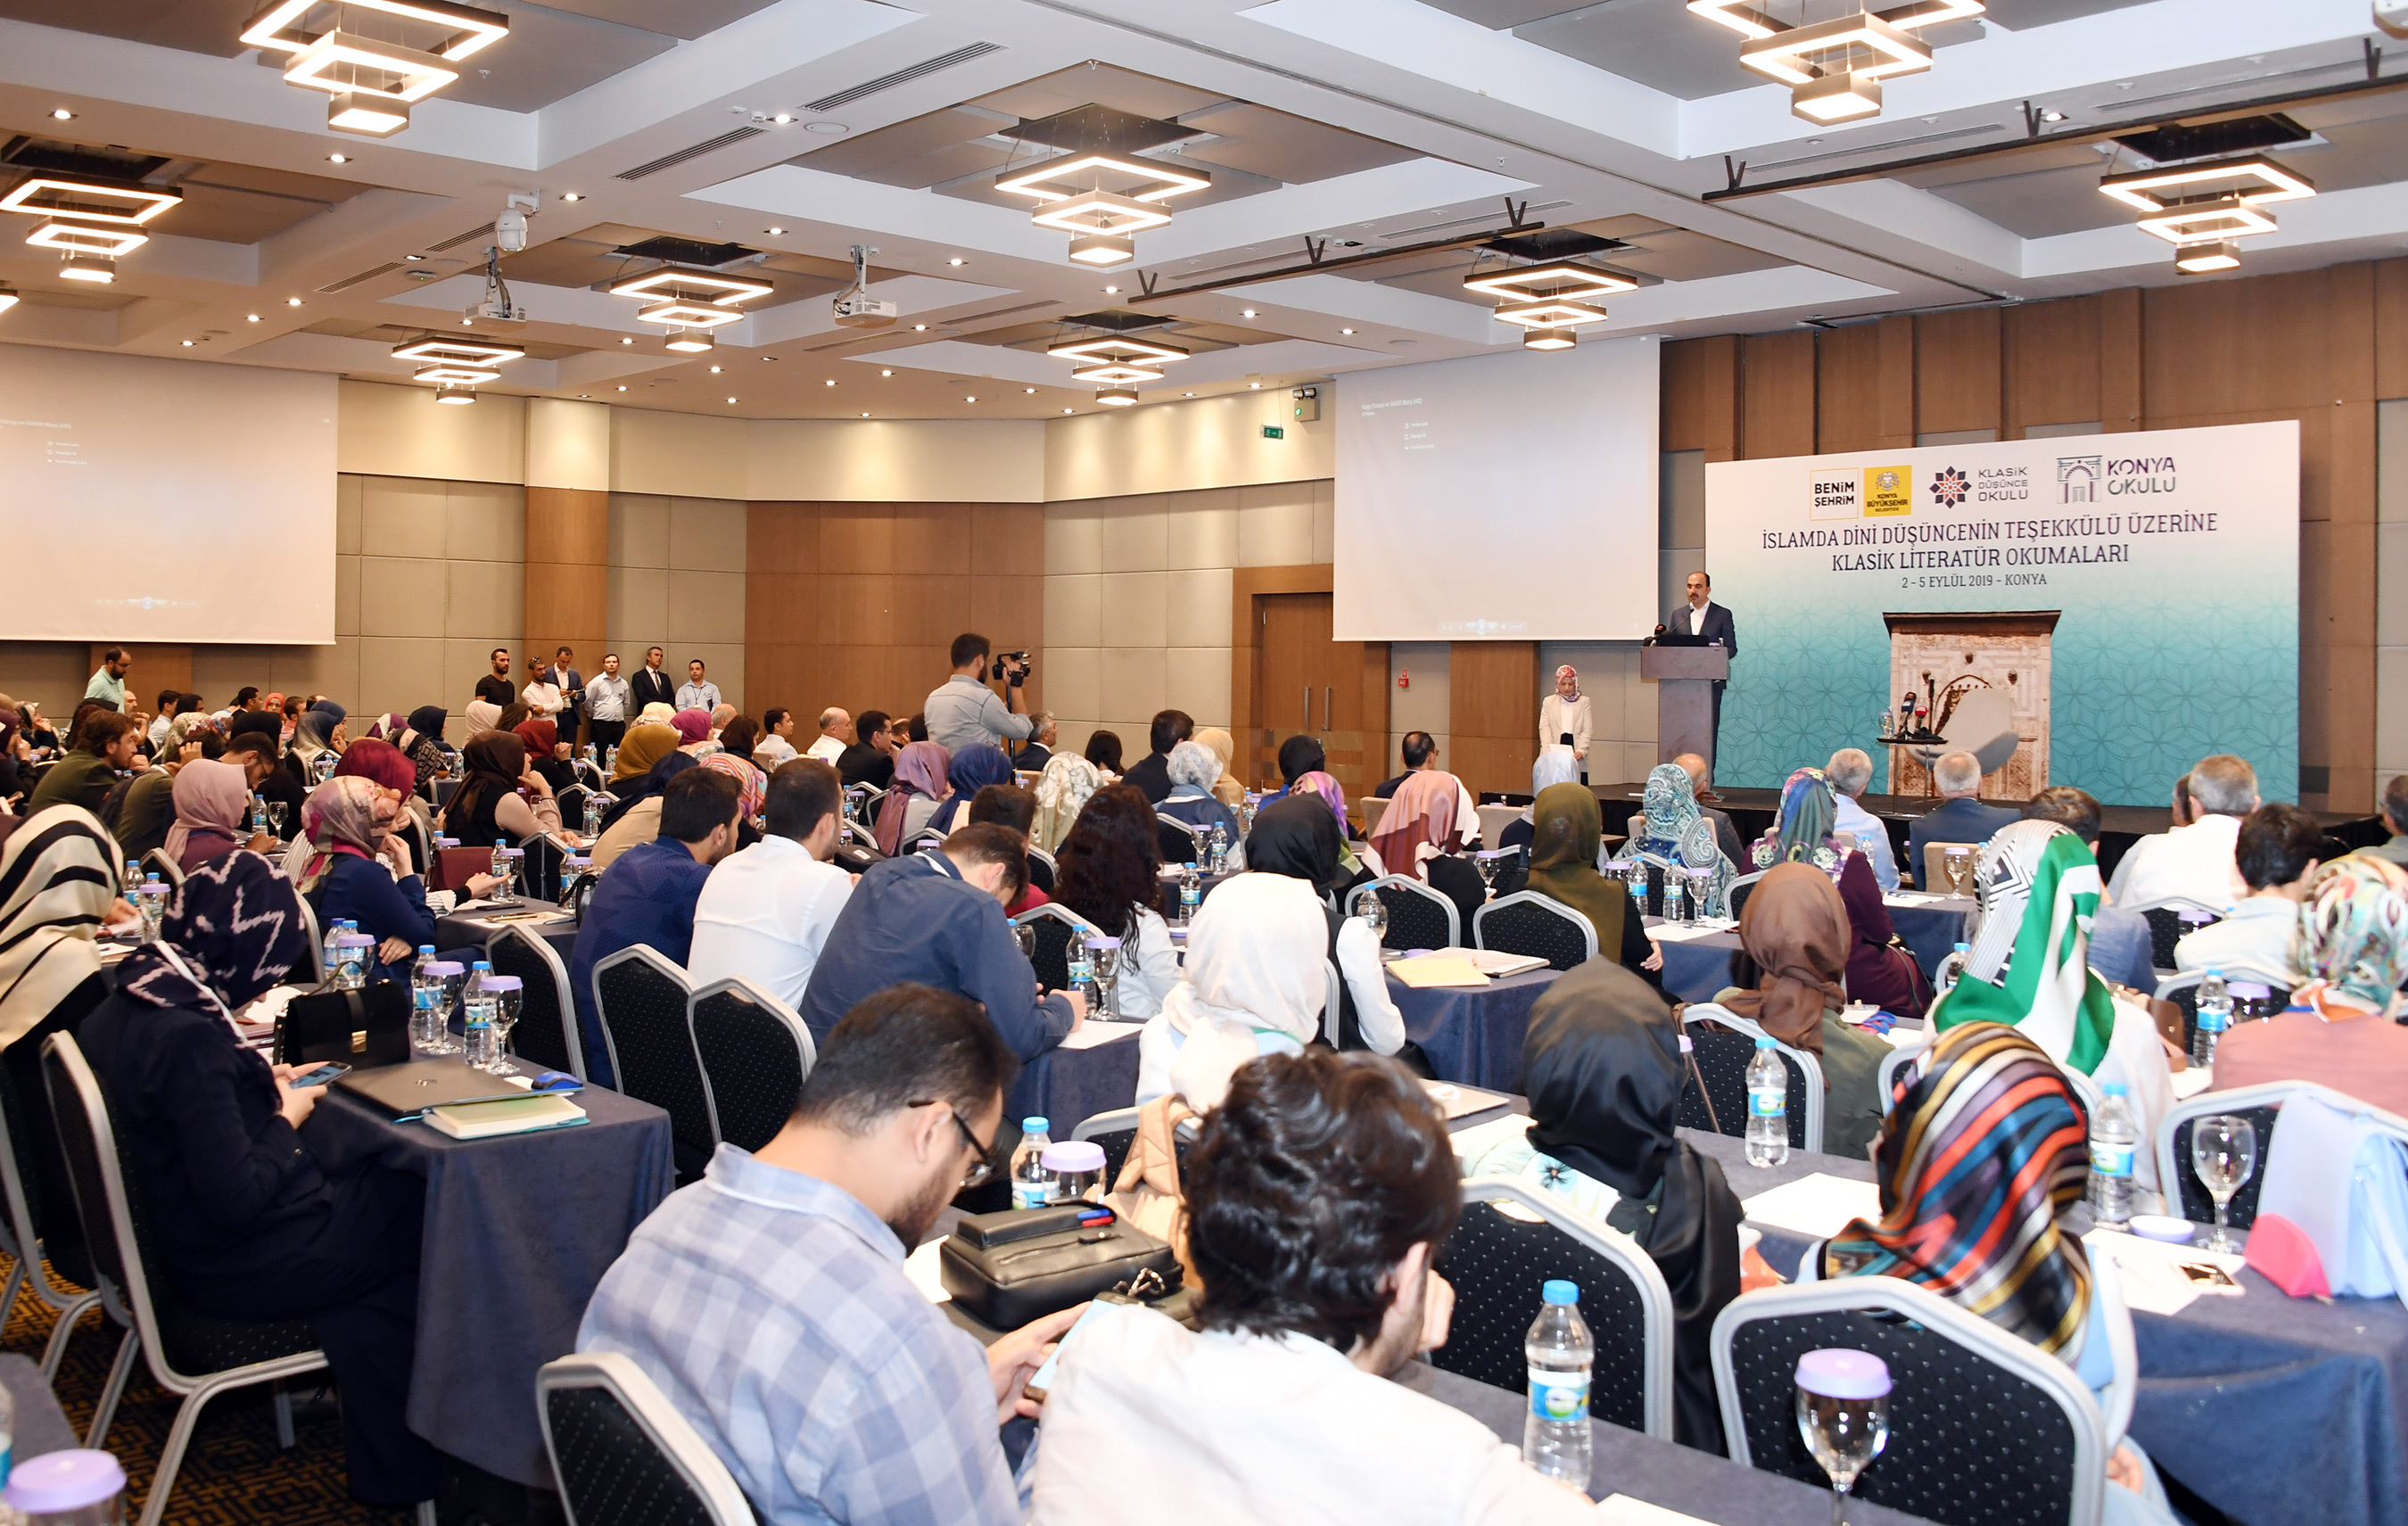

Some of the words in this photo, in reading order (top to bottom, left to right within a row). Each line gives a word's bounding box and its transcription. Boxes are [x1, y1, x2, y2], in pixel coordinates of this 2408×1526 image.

[2107, 457, 2175, 476] KONYA
[2107, 476, 2175, 496] OKULU
[1977, 490, 2029, 502] OKULU
[1762, 529, 1839, 549] İSLAMDA
[1843, 524, 1877, 546] DİNİ
[1882, 519, 2000, 547] DÜŞÜNCENİN
[2005, 514, 2122, 542] TEŞEKKÜLÜ
[2129, 510, 2218, 534] ÜZERİNE
[1832, 549, 1895, 572] KLASİK
[1900, 546, 2001, 569] LİTERATÜR
[2006, 544, 2130, 566] OKUMALARI
[1901, 577, 1909, 589] 2
[1918, 576, 1926, 589] 5
[1929, 573, 1967, 588] EYLÜL
[1968, 574, 1993, 587] 2019
[2005, 573, 2048, 586] KONYA
